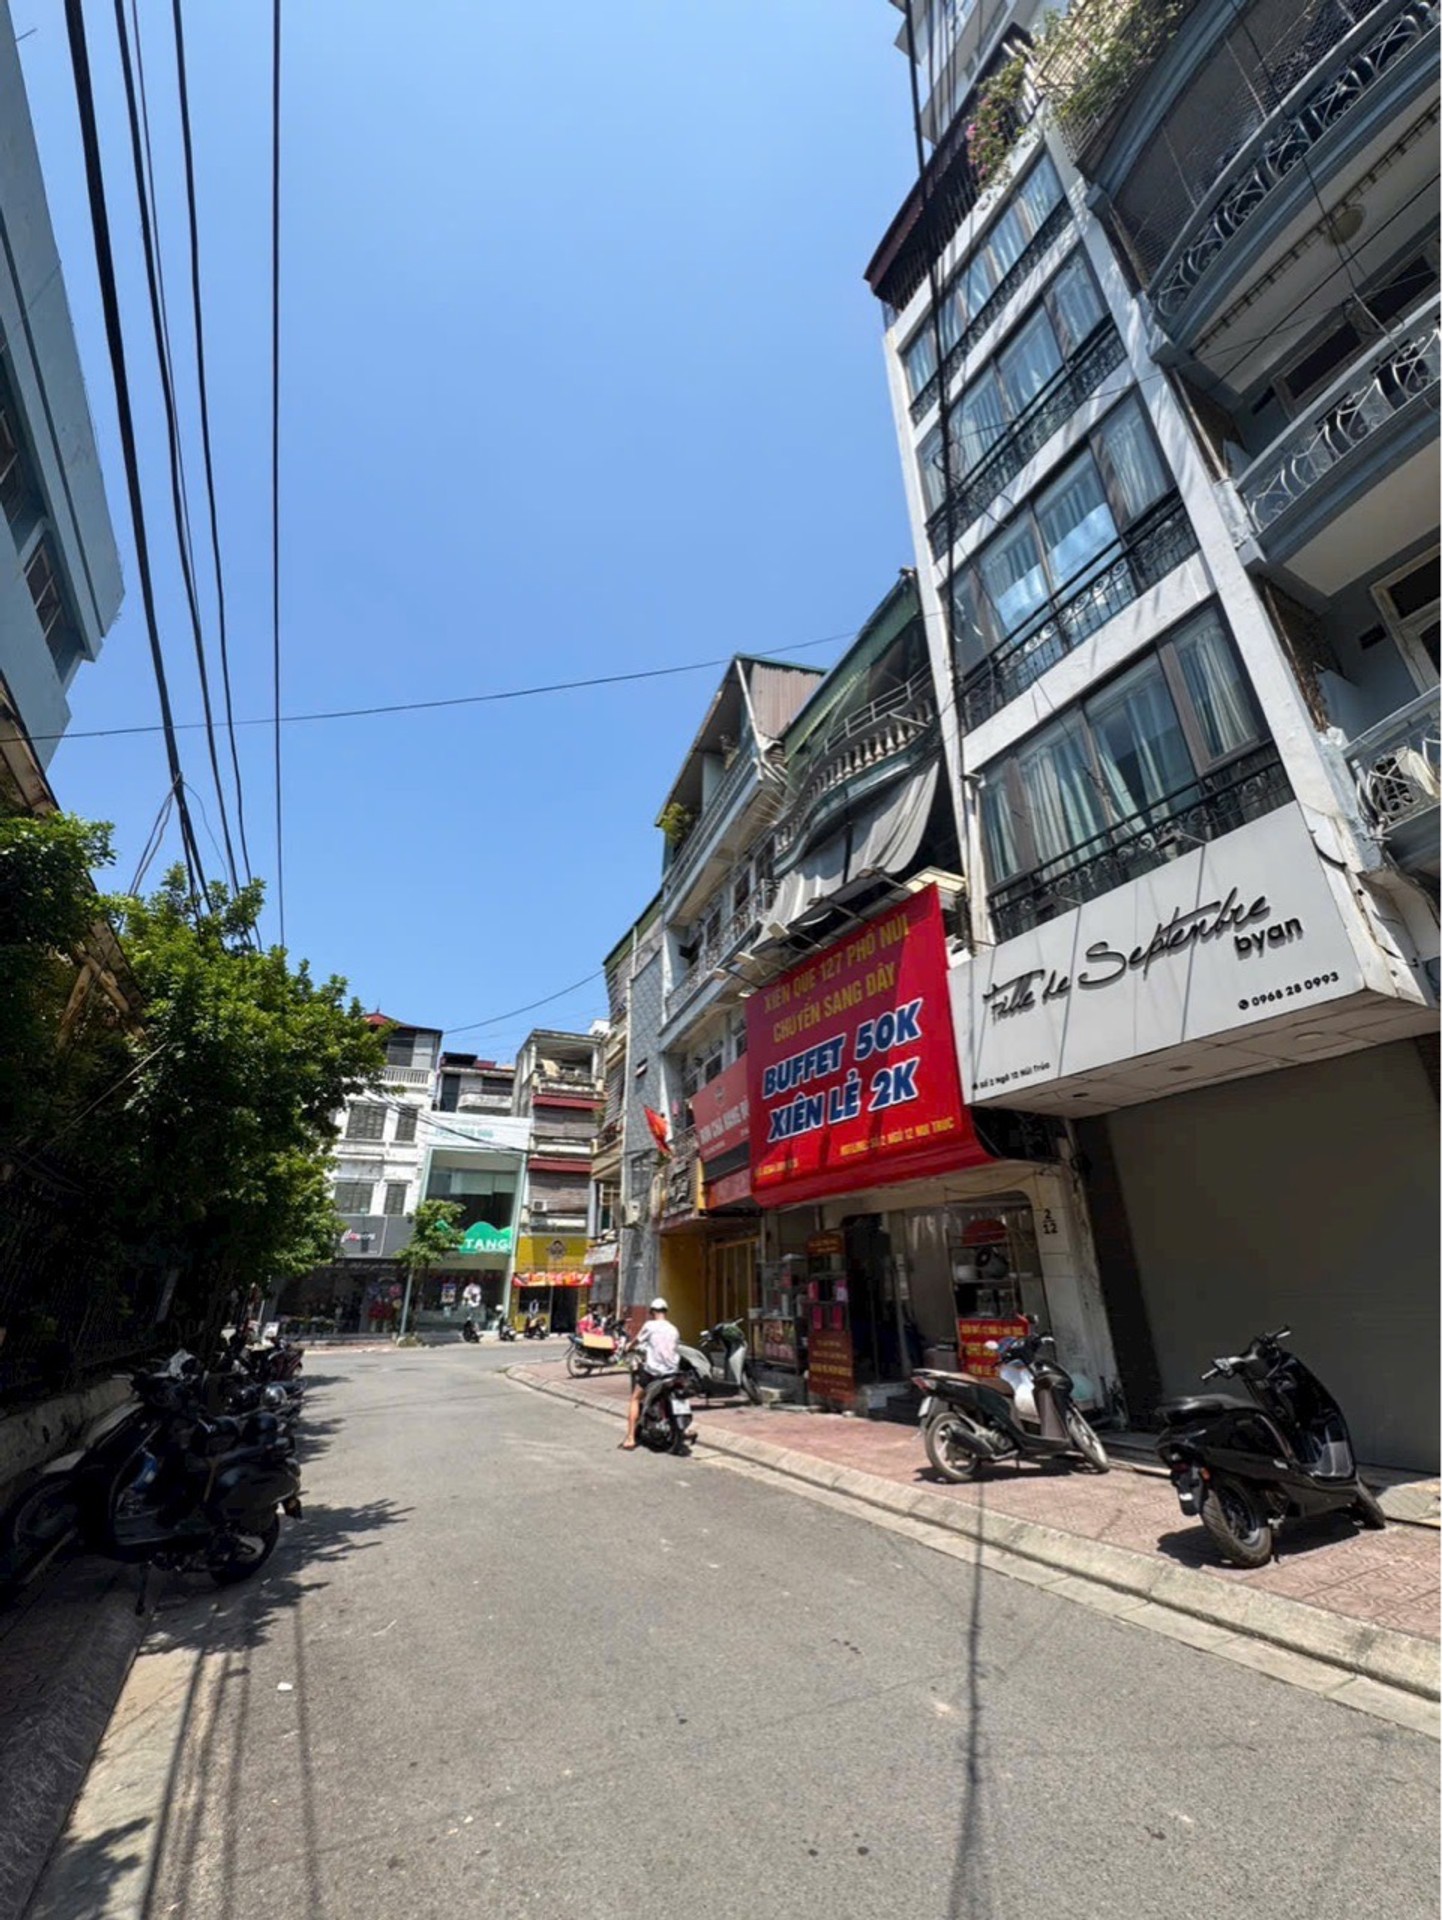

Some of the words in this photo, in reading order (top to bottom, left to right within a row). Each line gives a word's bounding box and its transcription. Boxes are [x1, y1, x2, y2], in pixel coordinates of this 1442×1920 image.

[1234, 918, 1303, 959] byan
[821, 951, 843, 982] 127
[823, 980, 863, 1018] SANG
[1251, 988, 1284, 1006] 0968
[1285, 983, 1302, 997] 28
[1304, 971, 1339, 990] 0993
[762, 1032, 847, 1099] BUFFET
[854, 997, 923, 1061] 50K
[767, 1091, 826, 1143] XIÊN
[827, 1068, 862, 1124] LẺ
[867, 1056, 920, 1111] 2K
